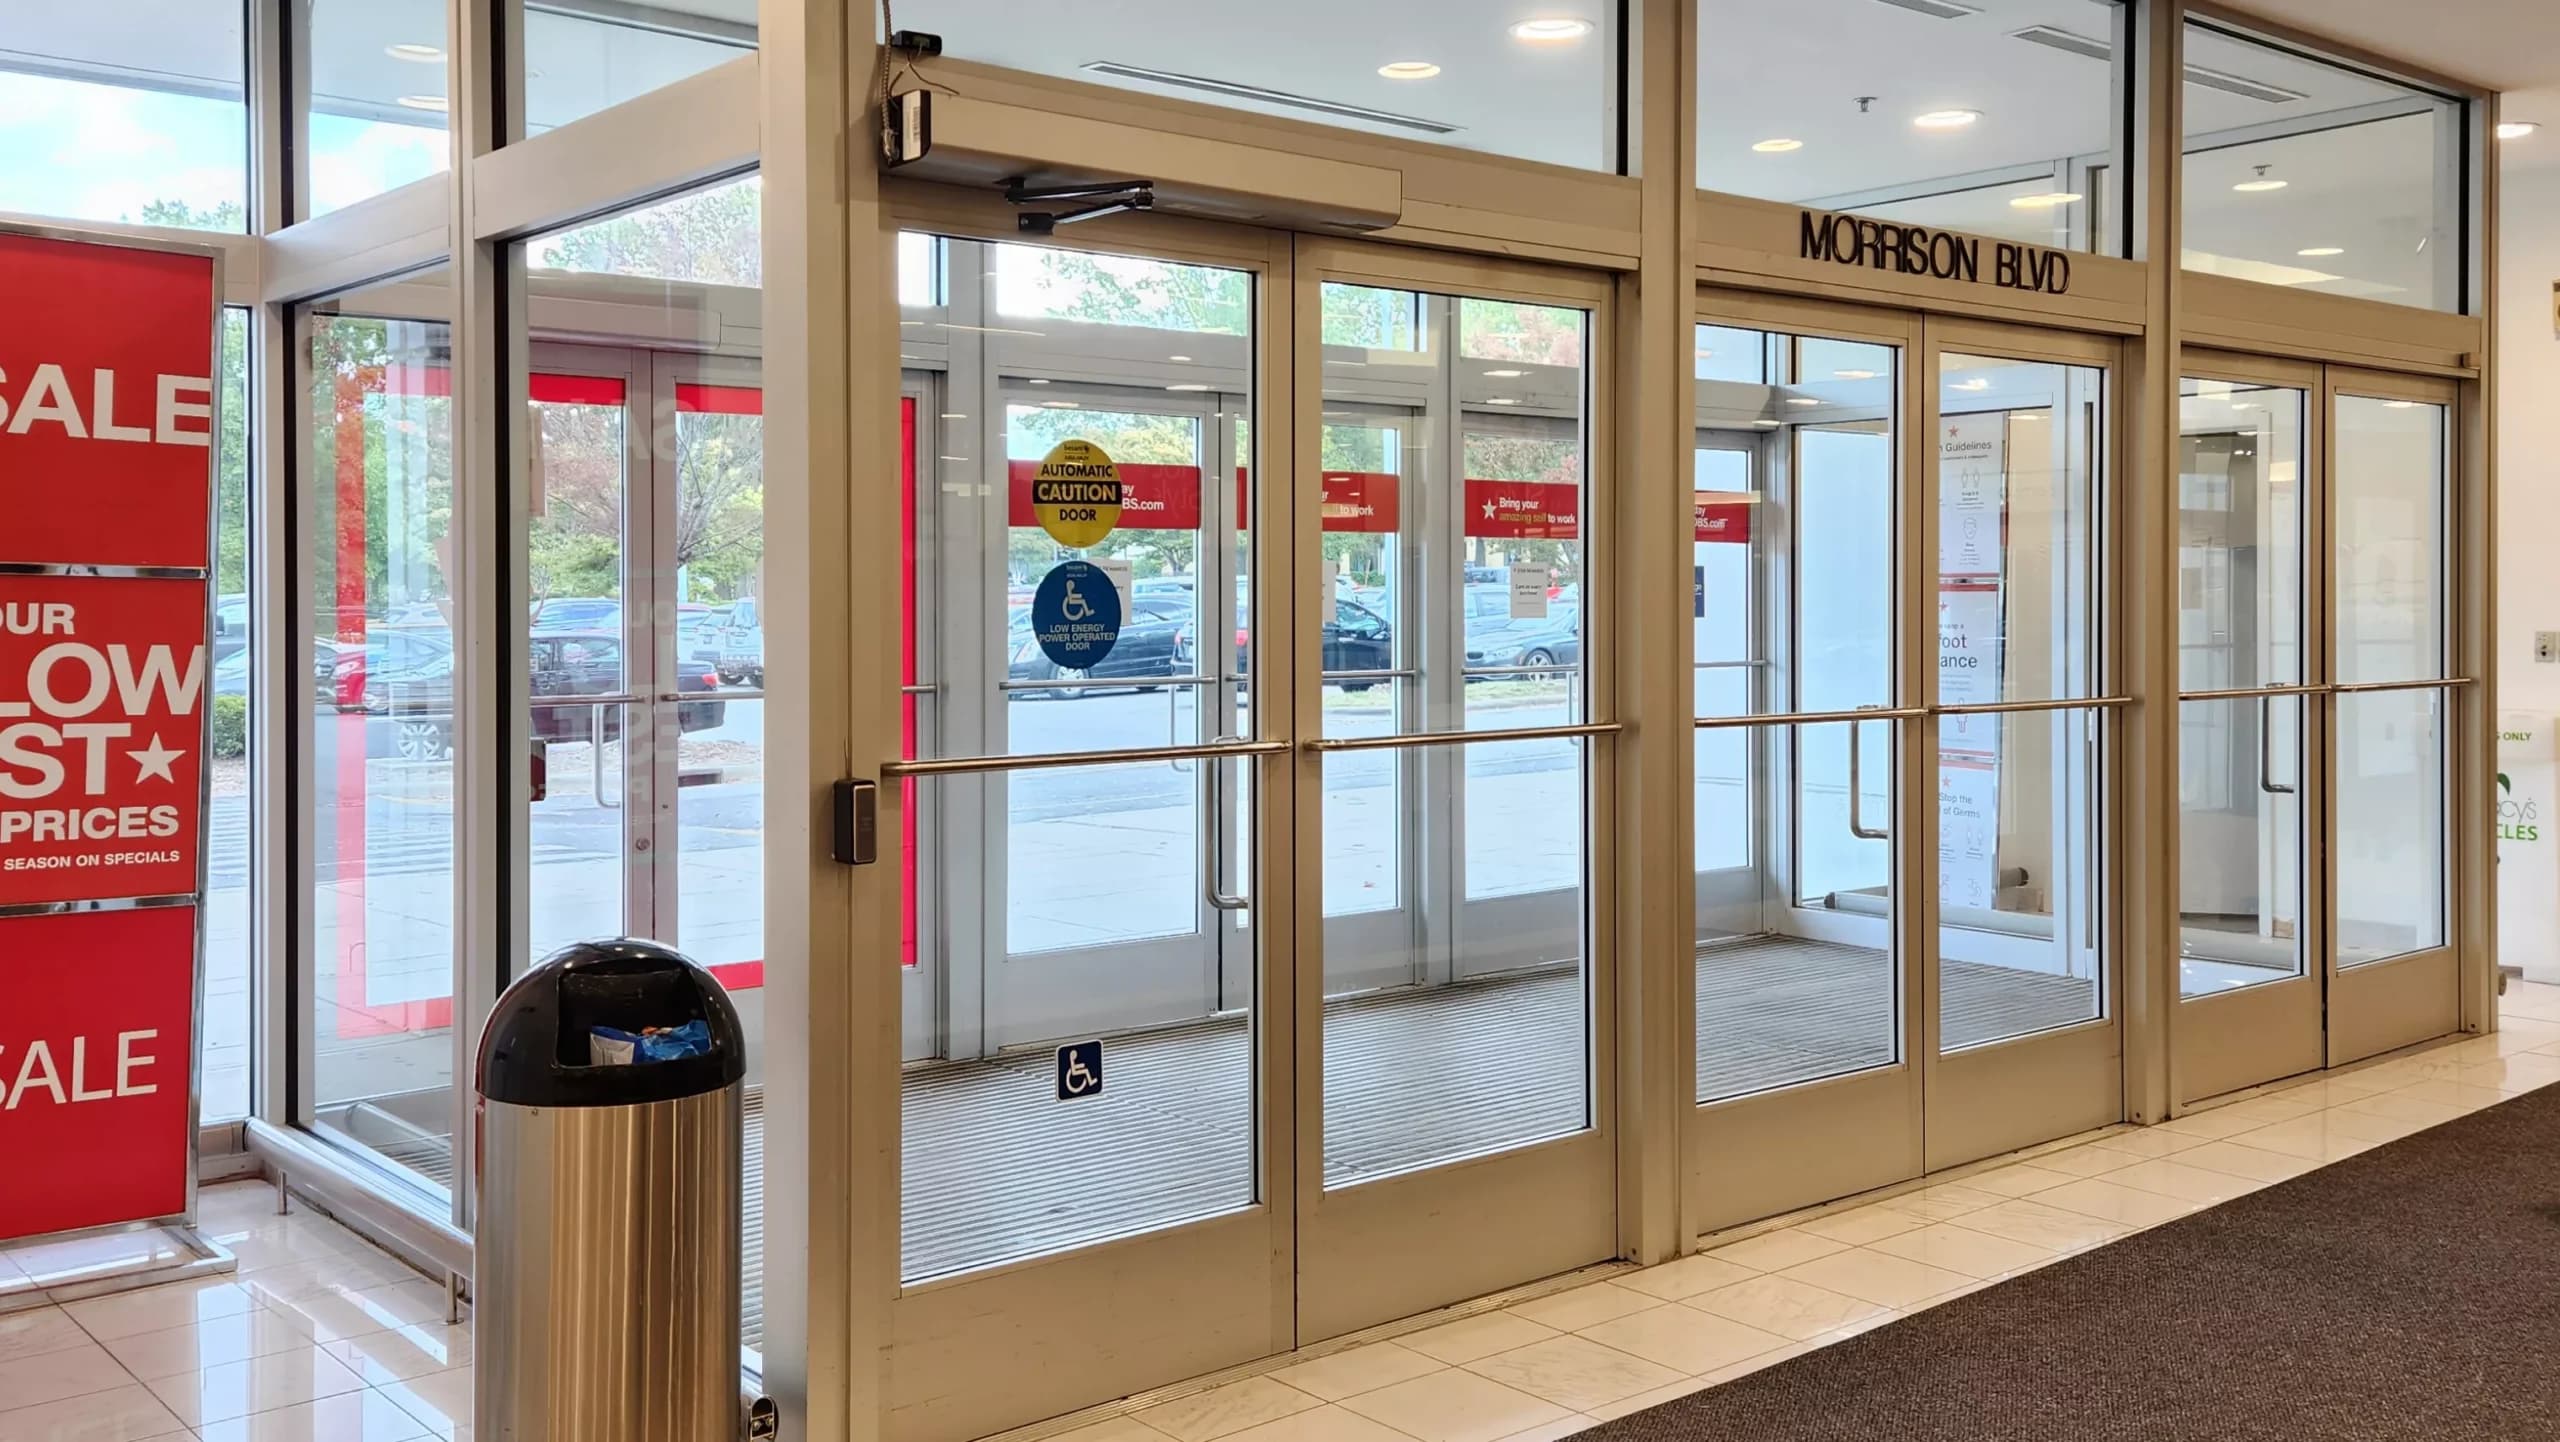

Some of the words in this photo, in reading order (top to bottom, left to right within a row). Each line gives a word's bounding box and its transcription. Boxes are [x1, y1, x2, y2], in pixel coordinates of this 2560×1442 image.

[1801, 210, 1978, 283] MORRISON
[1996, 242, 2071, 294] BLVD
[0, 363, 212, 447] ALE
[1945, 440, 1992, 453] Guidelines
[1041, 463, 1113, 478] AUTOMATIC
[1038, 482, 1117, 502] CAUTION
[1351, 505, 1374, 516] work
[1499, 497, 1521, 511] Bring
[1522, 499, 1540, 512] your
[1059, 508, 1097, 522] DOOR
[1548, 513, 1556, 523] to
[1557, 513, 1576, 524] work
[0, 602, 75, 635] UR
[1049, 624, 1070, 634] LOW
[1071, 623, 1105, 634] ENERGY
[1039, 633, 1071, 643] POWER
[1072, 631, 1116, 642] OPERATED
[1065, 641, 1091, 651] DOOR
[2503, 731, 2532, 741] ONLY
[0, 804, 179, 844] PRICES
[4, 856, 71, 871] SEASON
[76, 853, 100, 868] ON
[104, 850, 181, 865] SPECIALS
[0, 1029, 158, 1111] ALE
